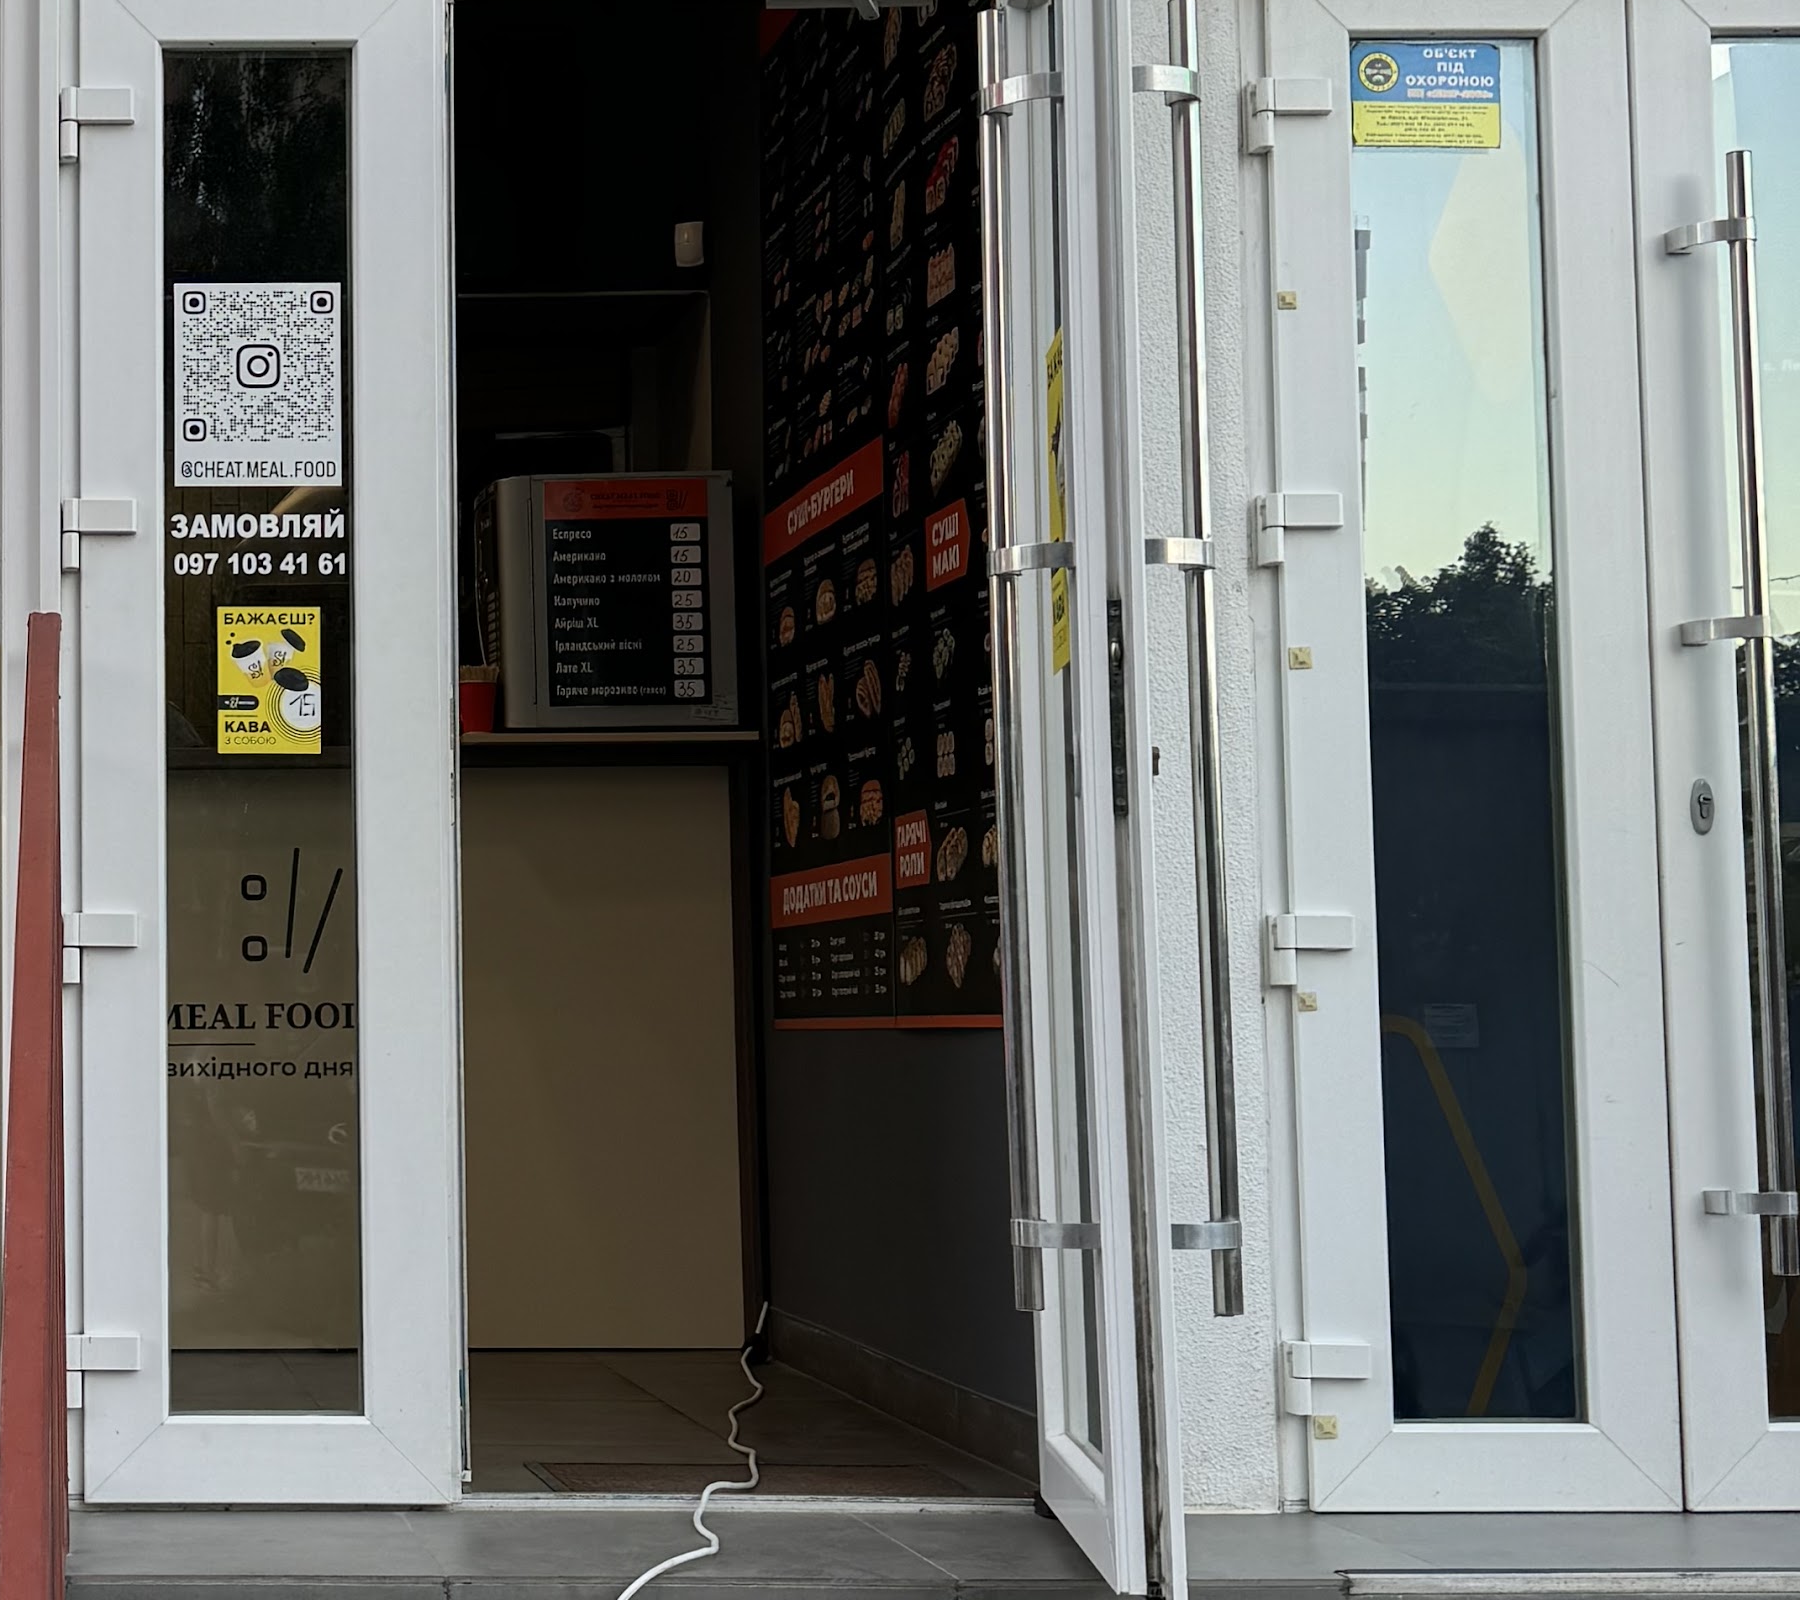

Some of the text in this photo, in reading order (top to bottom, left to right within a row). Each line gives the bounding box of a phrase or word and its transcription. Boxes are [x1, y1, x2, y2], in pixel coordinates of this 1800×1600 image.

[1436, 62, 1465, 75] ПІД
[1405, 75, 1495, 87] ОХОРОНОЮ
[180, 460, 337, 480] @CHEAT.MEAL.FOOD
[169, 507, 346, 540] ЗАМОВЛЯЙ
[552, 528, 592, 541] Еспресо
[673, 526, 689, 540] 15
[552, 550, 607, 564] Американо
[673, 548, 690, 563] 15
[932, 543, 961, 580] МАКІ
[173, 552, 347, 576] 097 103 41 61
[553, 573, 607, 587] Американо
[673, 570, 691, 584] 20
[674, 593, 694, 607] 25
[223, 612, 316, 626] БАЖАЄШ?
[586, 616, 599, 629] XL
[674, 615, 694, 630] 35
[676, 639, 696, 652] 25
[580, 661, 593, 673] XL
[677, 659, 697, 675] 35
[678, 681, 696, 697] 35
[224, 721, 272, 734] КАВА
[233, 736, 277, 745] СОБОЮ
[827, 877, 842, 904] ТА
[842, 870, 878, 902] СОУСИ
[304, 1060, 354, 1080] дня
